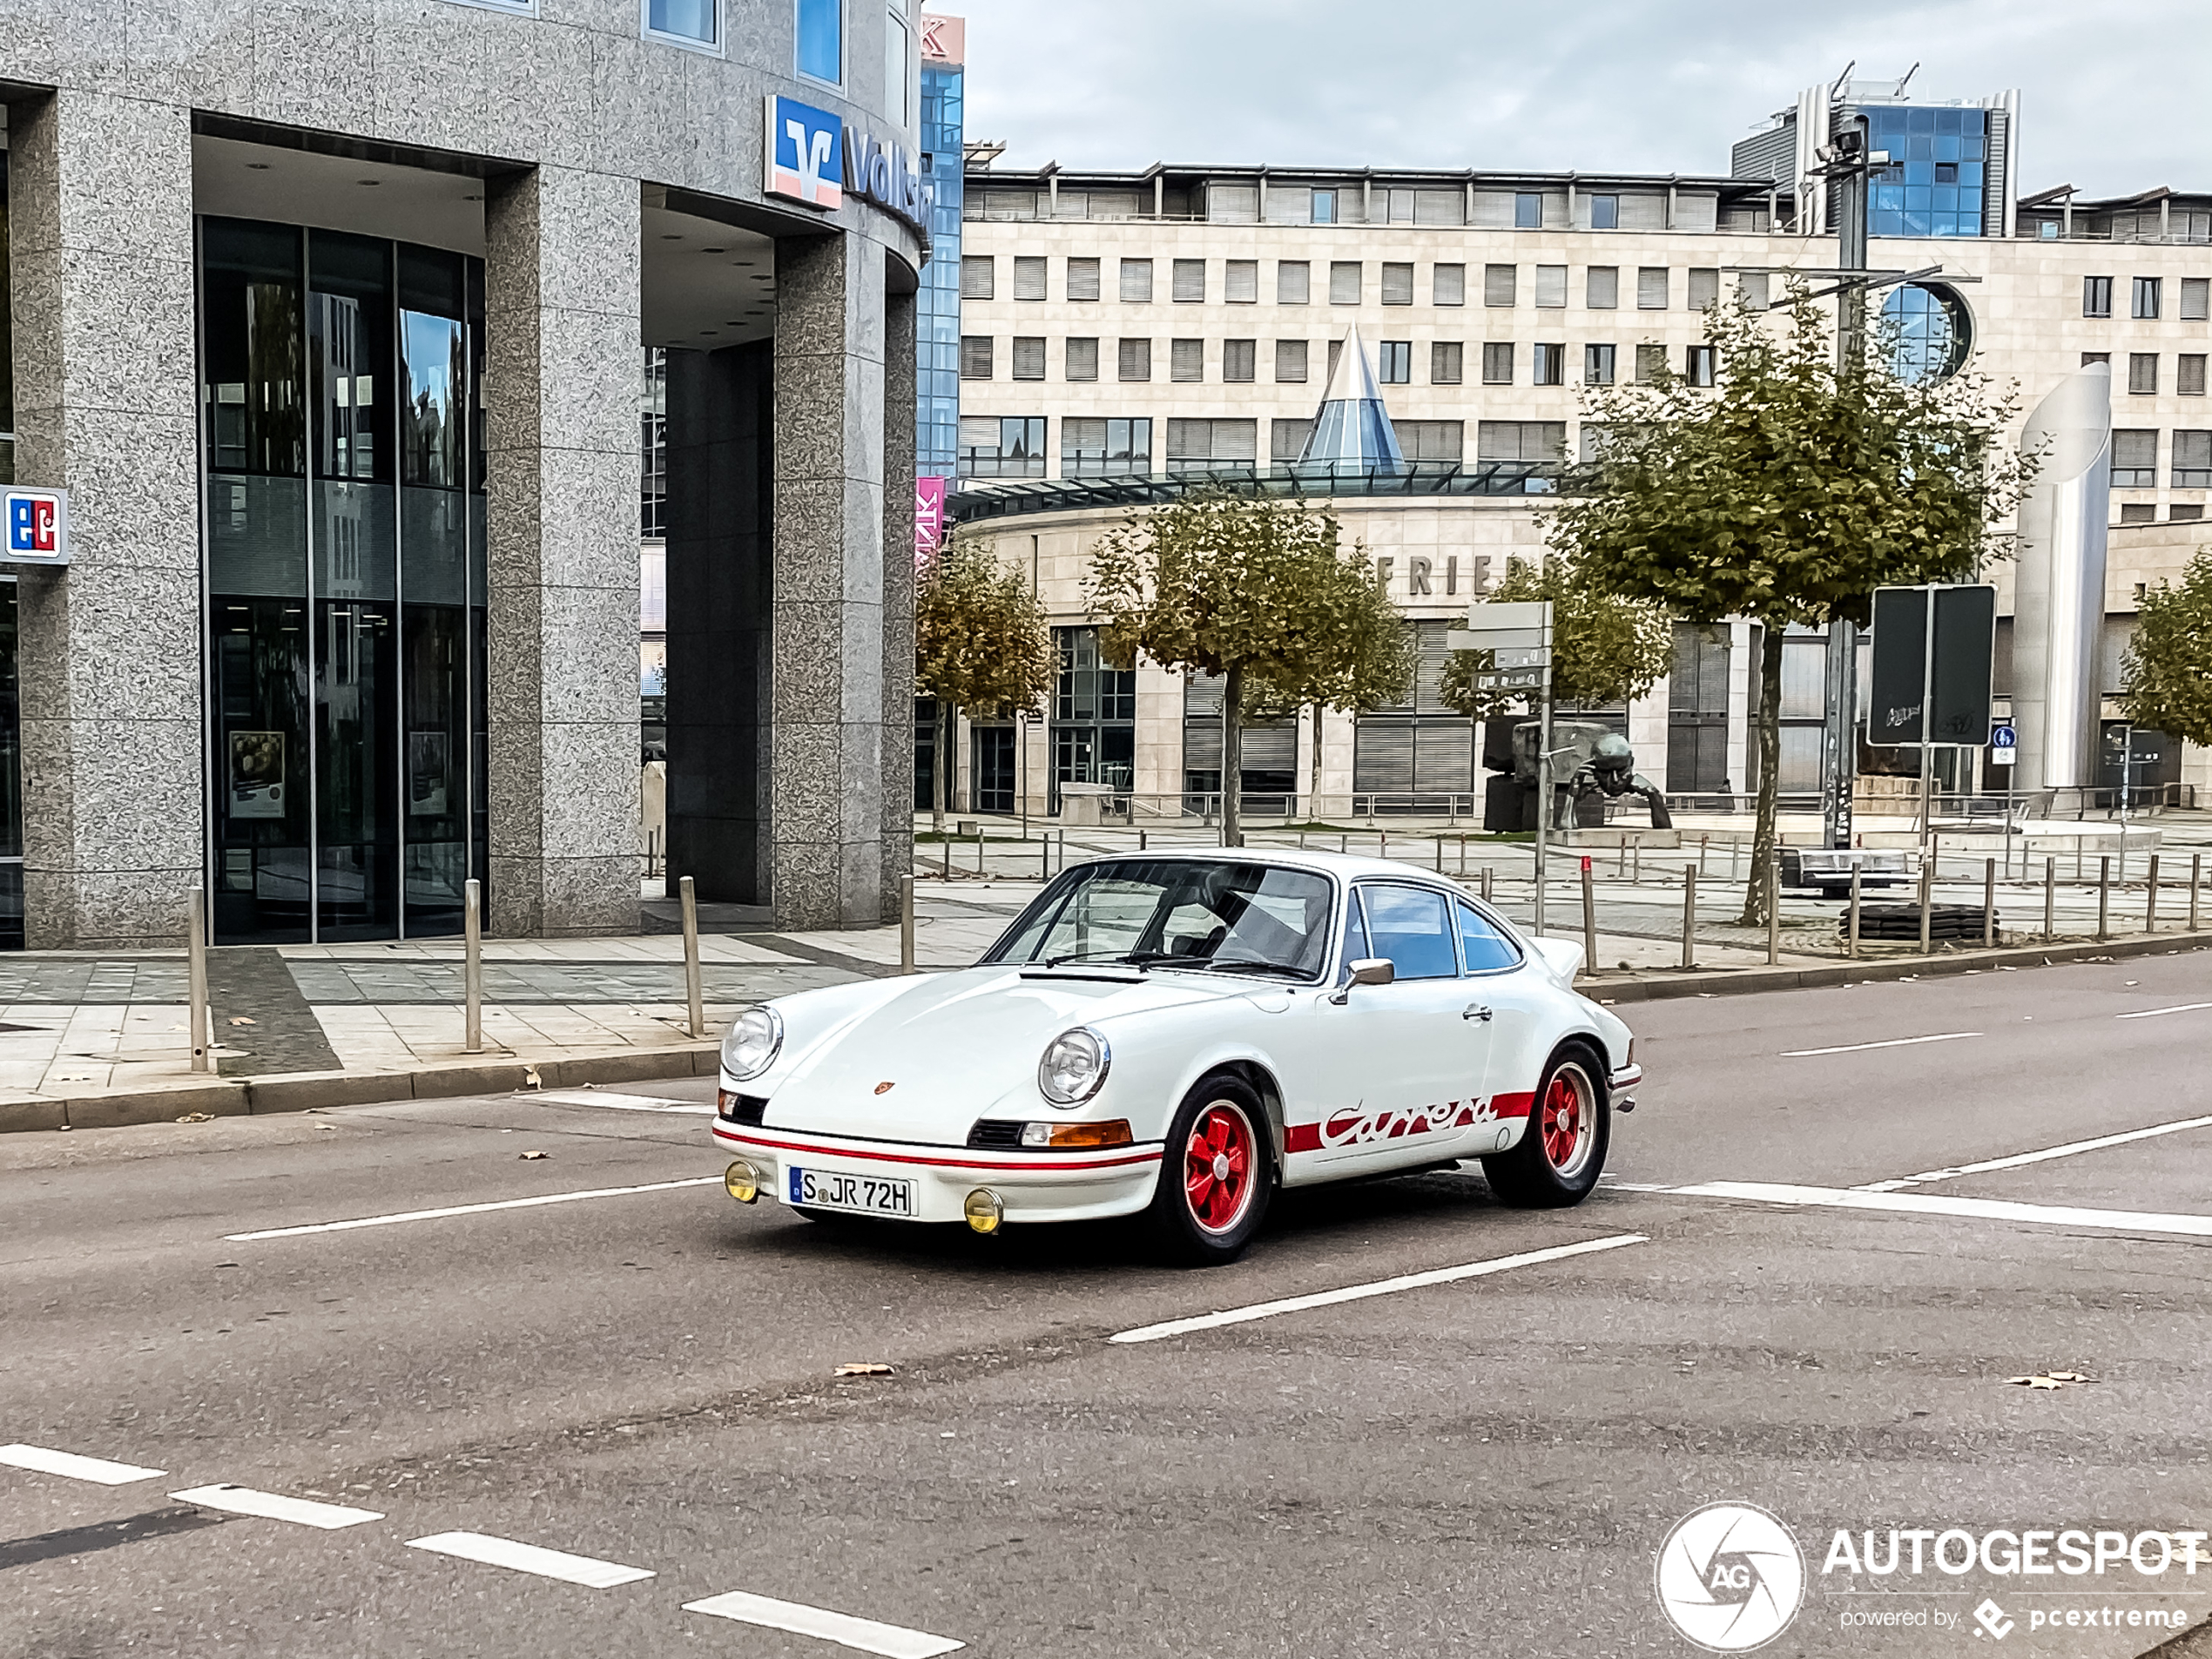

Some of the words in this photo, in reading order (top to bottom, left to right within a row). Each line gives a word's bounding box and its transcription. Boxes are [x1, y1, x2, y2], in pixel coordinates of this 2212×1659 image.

[1318, 1097, 1499, 1150] Carrera
[803, 1173, 816, 1199] S
[831, 1177, 858, 1205] JR
[864, 1180, 907, 1211] 72H
